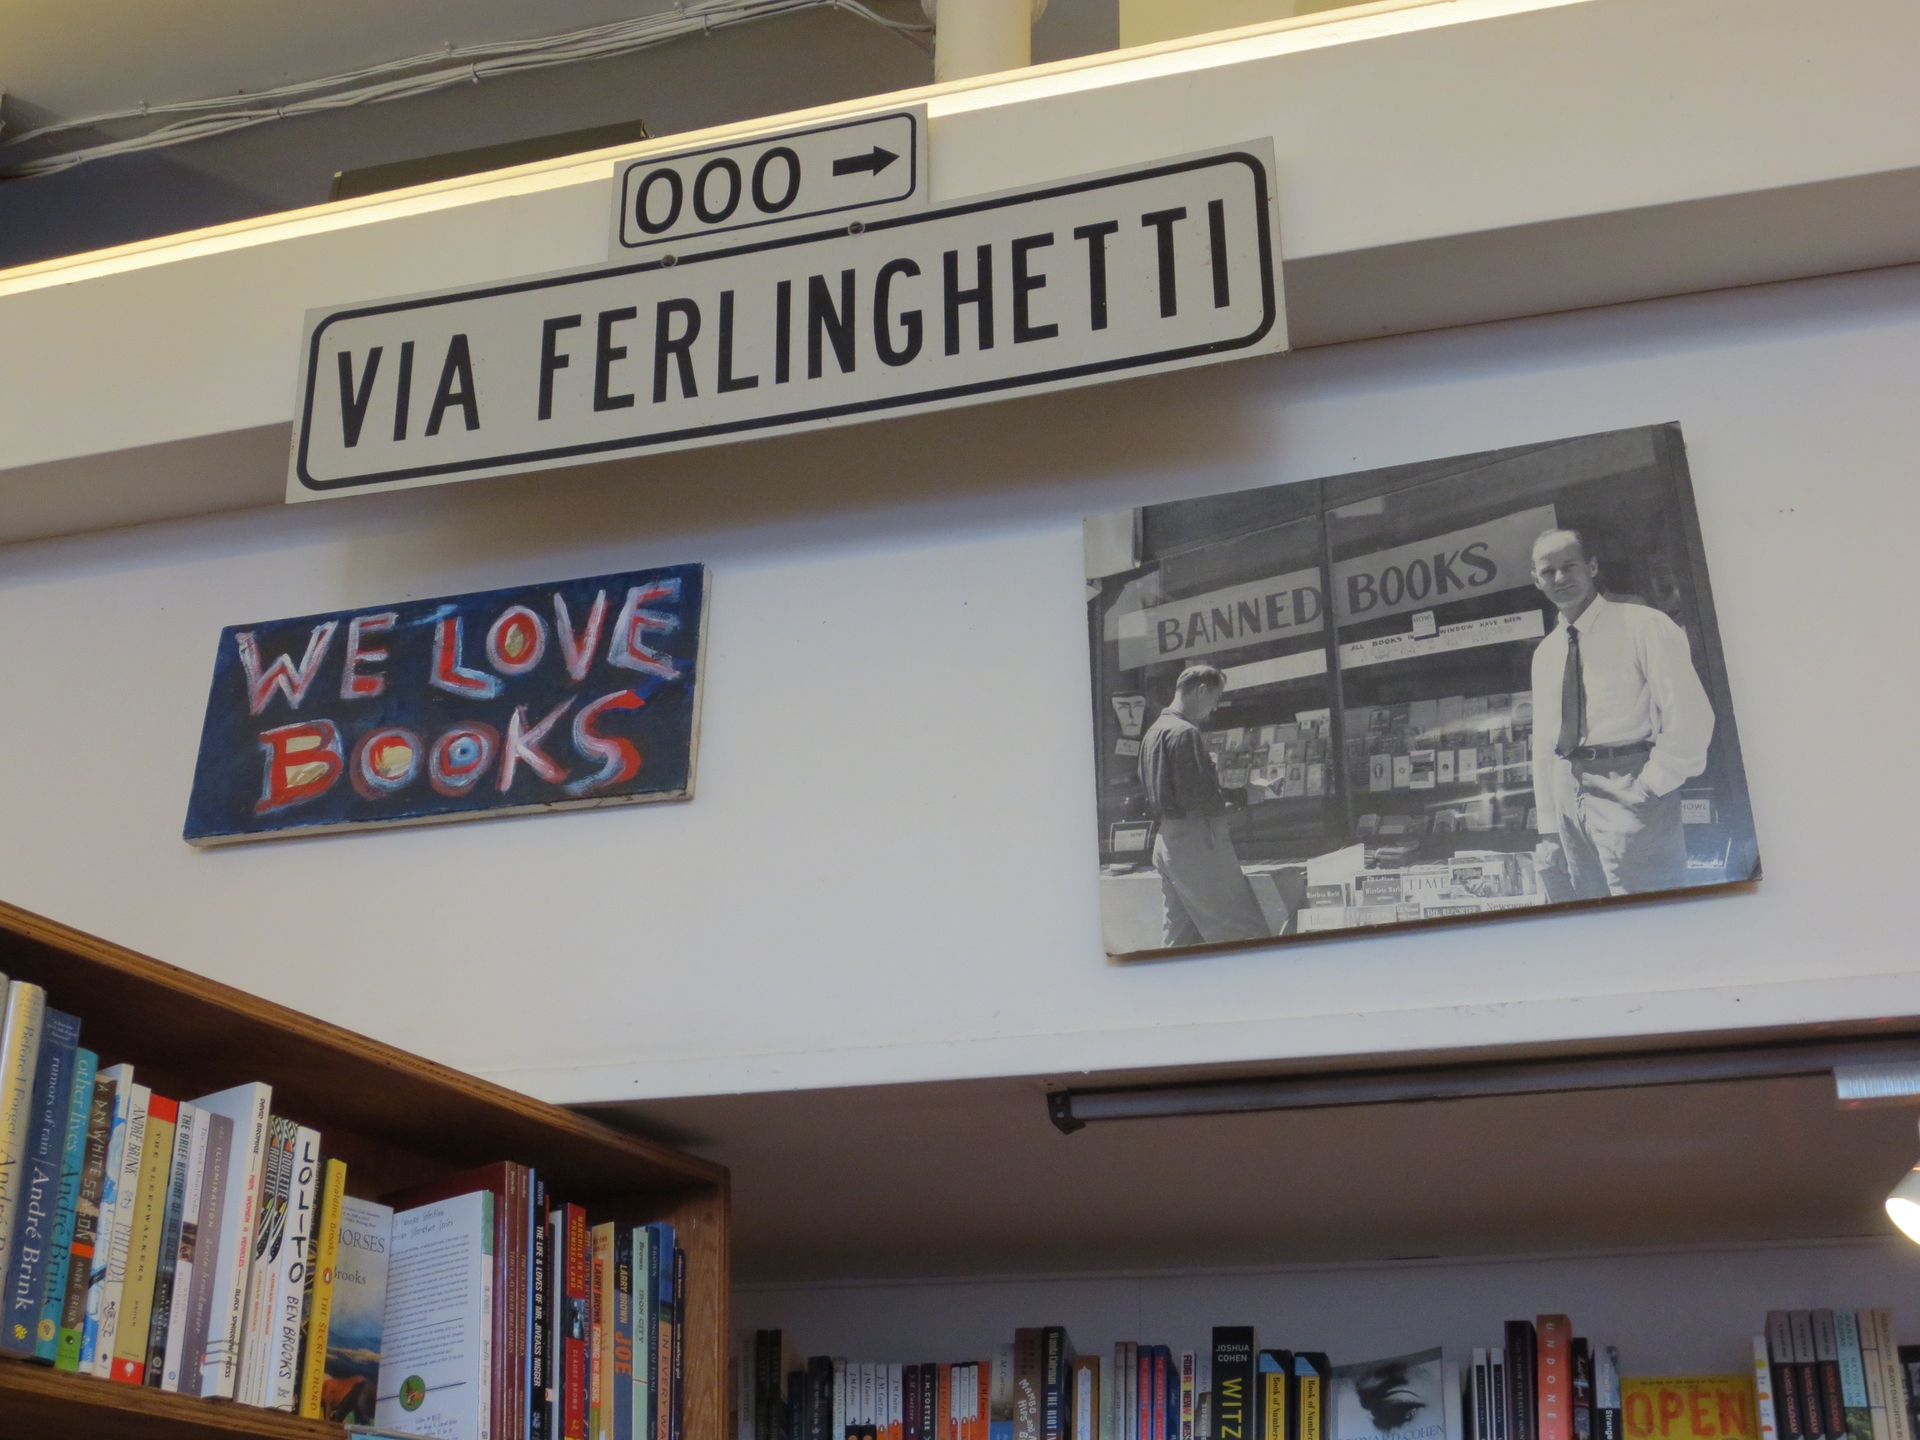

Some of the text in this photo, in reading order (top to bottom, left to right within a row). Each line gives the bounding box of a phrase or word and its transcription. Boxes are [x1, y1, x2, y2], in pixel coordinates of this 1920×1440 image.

[337, 199, 1231, 448] VIA FERLINGHETTI
[1157, 541, 1498, 654] BANNED BOOKS
[1351, 643, 1364, 651] ALL
[1372, 637, 1403, 647] BOOKS
[1439, 623, 1474, 635] WINDOW
[1479, 620, 1498, 628] HAVE
[1504, 616, 1522, 624] BEEN
[1413, 614, 1434, 623] HOWL
[235, 578, 682, 715] WE LOVE
[255, 690, 646, 815] BOOKS
[1366, 887, 1387, 895] Wireless
[1406, 878, 1449, 890] TIME
[1426, 909, 1440, 917] THE
[1443, 907, 1477, 916] REPORTER
[5, 1026, 34, 1136] Before Forget
[53, 1060, 92, 1235] other lives André
[89, 1098, 108, 1177] DRY WHITE
[124, 1145, 141, 1177] BRINK
[170, 1113, 192, 1214] THE BRIEF HISTORY OF
[264, 1146, 280, 1196] ROULETTE
[277, 1151, 293, 1200] ROULETTE
[15, 1057, 60, 1310] rumors of rain André Brink
[206, 1146, 222, 1228] ILLUMINATION
[138, 1131, 162, 1282] THE SLEEPWALKERS
[289, 1141, 315, 1283] LOLITO
[224, 1098, 266, 1379] DAVID BROMIGE WOMEN VEHICLES BLACK SPARROW PRESS
[535, 1241, 543, 1257] LIFE
[536, 1226, 544, 1240] THE
[107, 1222, 131, 1283] PHILIDA
[577, 1262, 583, 1271] IN
[311, 1172, 343, 1411] Geraldine Brooks THE SECRET CHORD
[535, 1267, 543, 1291] LOVES
[593, 1261, 602, 1290] LARRY
[68, 1294, 79, 1323] BRINK
[250, 1268, 263, 1332] ADRIAN BROOKS
[264, 1272, 277, 1336] ADRIAN BROOKS
[285, 1295, 299, 1322] BEN
[535, 1294, 542, 1304] OF
[592, 1293, 602, 1324] BROWN
[615, 1264, 632, 1377] LARRY BROWN JOE
[1837, 1314, 1846, 1347] COLEMAN
[278, 1326, 296, 1380] BROOKS
[534, 1321, 542, 1355] JIVEASS
[592, 1326, 601, 1359] FACING
[662, 1333, 669, 1349] IN
[1216, 1344, 1250, 1352] JOSHUA
[533, 1359, 542, 1387] NIGGER
[651, 1353, 657, 1364] OF
[1217, 1354, 1248, 1362] COHEN
[1545, 1322, 1556, 1419] UNDONE
[1843, 1357, 1851, 1385] STRANGE
[1851, 1357, 1860, 1384] NATIVE
[591, 1373, 600, 1403] MUSIC
[661, 1355, 669, 1408] EVERY
[1046, 1332, 1059, 1429] Wanda Coleman THE RIOT
[1273, 1376, 1281, 1396] Book
[1307, 1380, 1316, 1399] Book
[1804, 1367, 1813, 1395] WANDA
[1826, 1365, 1836, 1393] WANDA
[1018, 1399, 1028, 1421] HIPS
[1019, 1378, 1036, 1414] MAMBO
[1221, 1377, 1242, 1438] WITZ
[1273, 1397, 1281, 1407] of
[1307, 1401, 1316, 1410] of
[1625, 1387, 1748, 1438] OPEN
[1782, 1367, 1798, 1434] WANDA COLEMAN
[1888, 1364, 1902, 1429] HEAVY DAUGHTER
[1027, 1419, 1035, 1433] and
[1605, 1410, 1613, 1440] Strange
[1807, 1396, 1819, 1434] COLEMAN
[1830, 1394, 1841, 1432] COLEMAN
[1404, 1424, 1444, 1440] COHEN
